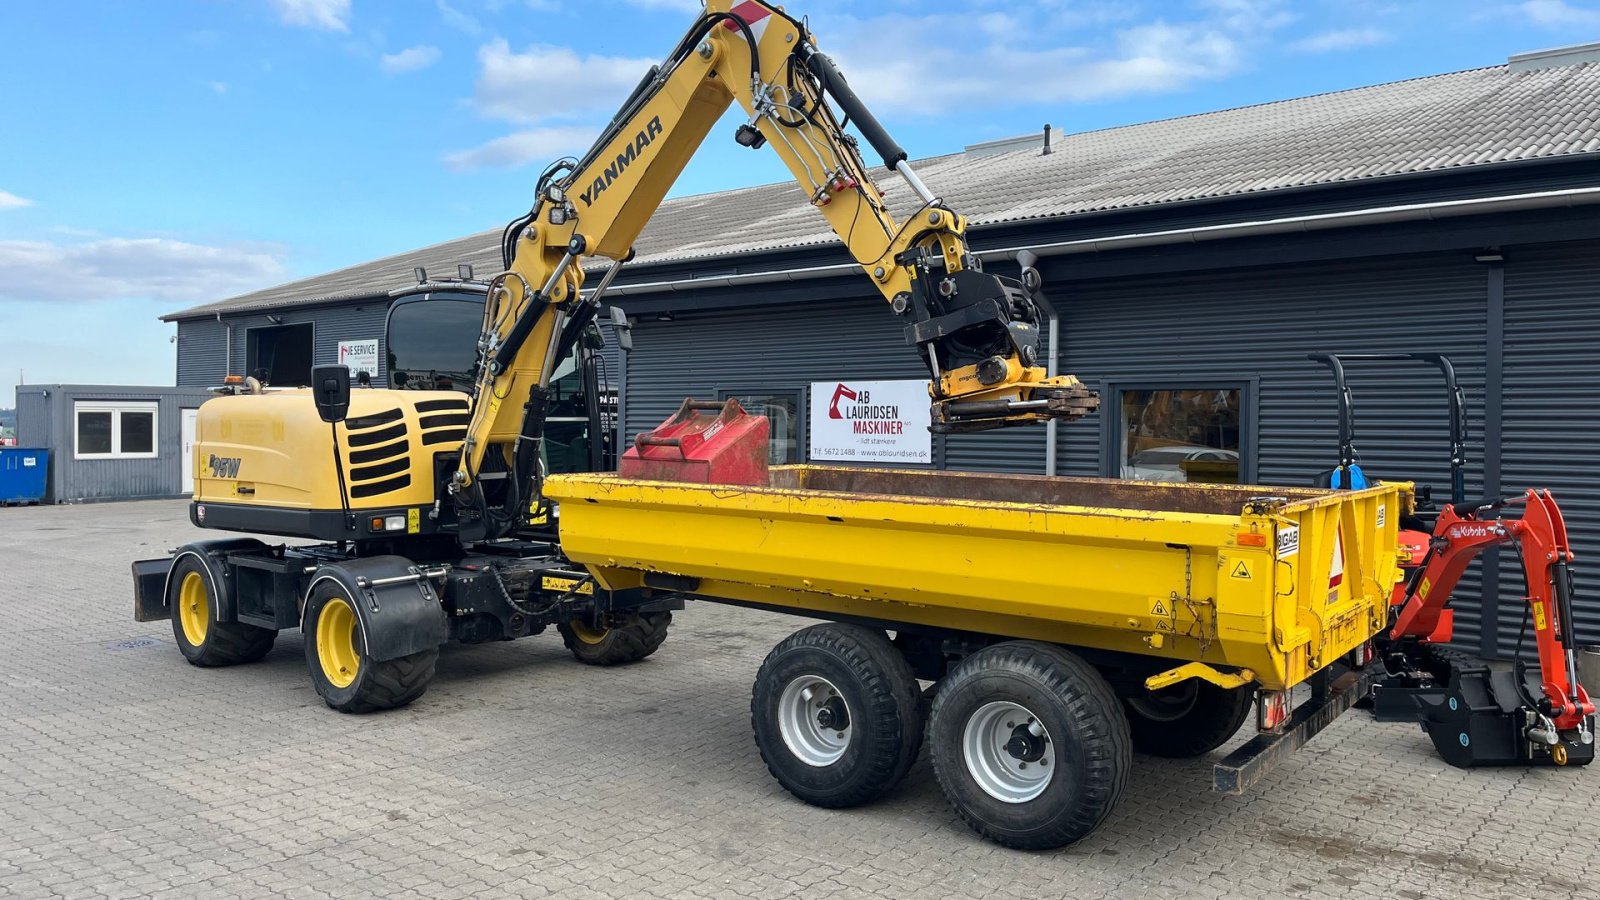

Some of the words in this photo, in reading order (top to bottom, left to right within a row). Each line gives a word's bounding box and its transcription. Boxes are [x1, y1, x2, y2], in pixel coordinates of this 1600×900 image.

[579, 115, 663, 208] YANMAR
[354, 344, 376, 355] SERVICE
[958, 374, 977, 382] engco
[858, 391, 869, 404] AB
[846, 405, 898, 420] LAURIDSEN
[853, 420, 903, 434] MASKINER
[824, 448, 839, 456] 5672
[840, 448, 855, 456] 1488
[860, 449, 927, 457] www.ablauridsen.dk
[1460, 526, 1486, 536] Kubota
[1278, 530, 1297, 547] BIGAB
